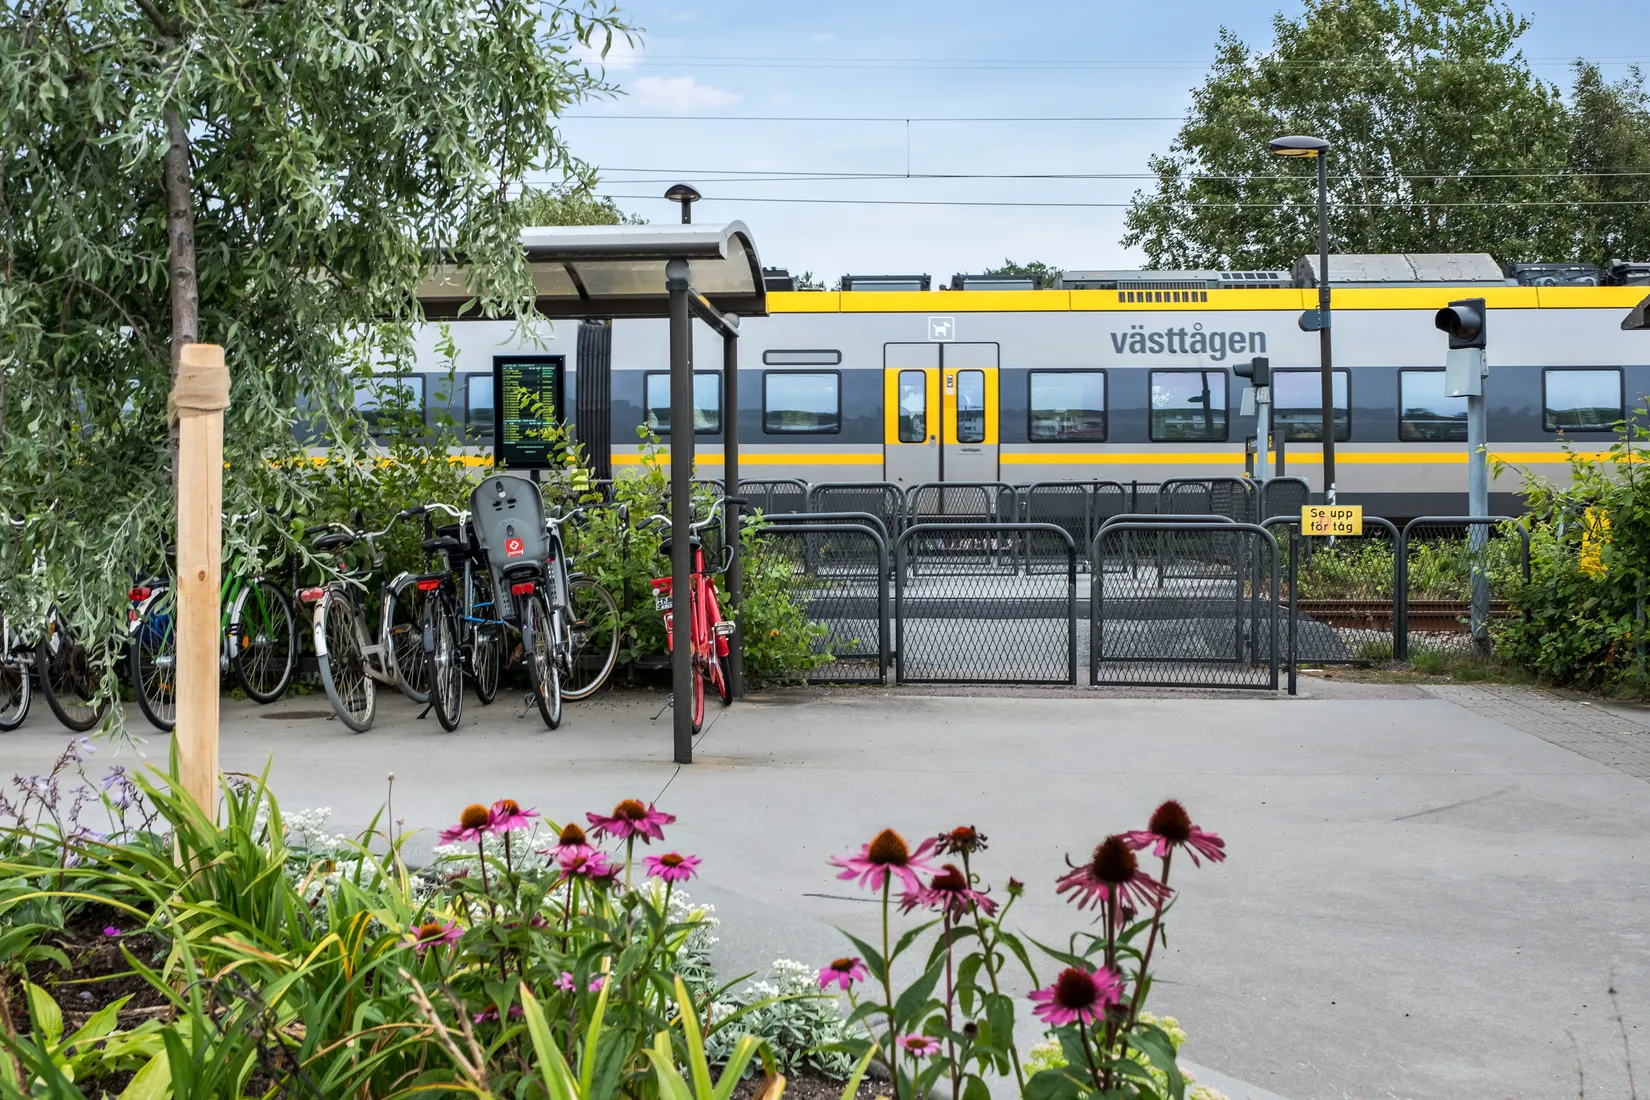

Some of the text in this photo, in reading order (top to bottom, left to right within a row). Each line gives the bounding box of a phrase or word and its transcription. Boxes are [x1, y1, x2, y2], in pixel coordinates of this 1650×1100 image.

[1110, 322, 1267, 361] västtågen
[1310, 508, 1353, 520] Se upp
[1310, 521, 1353, 533] för tåg
